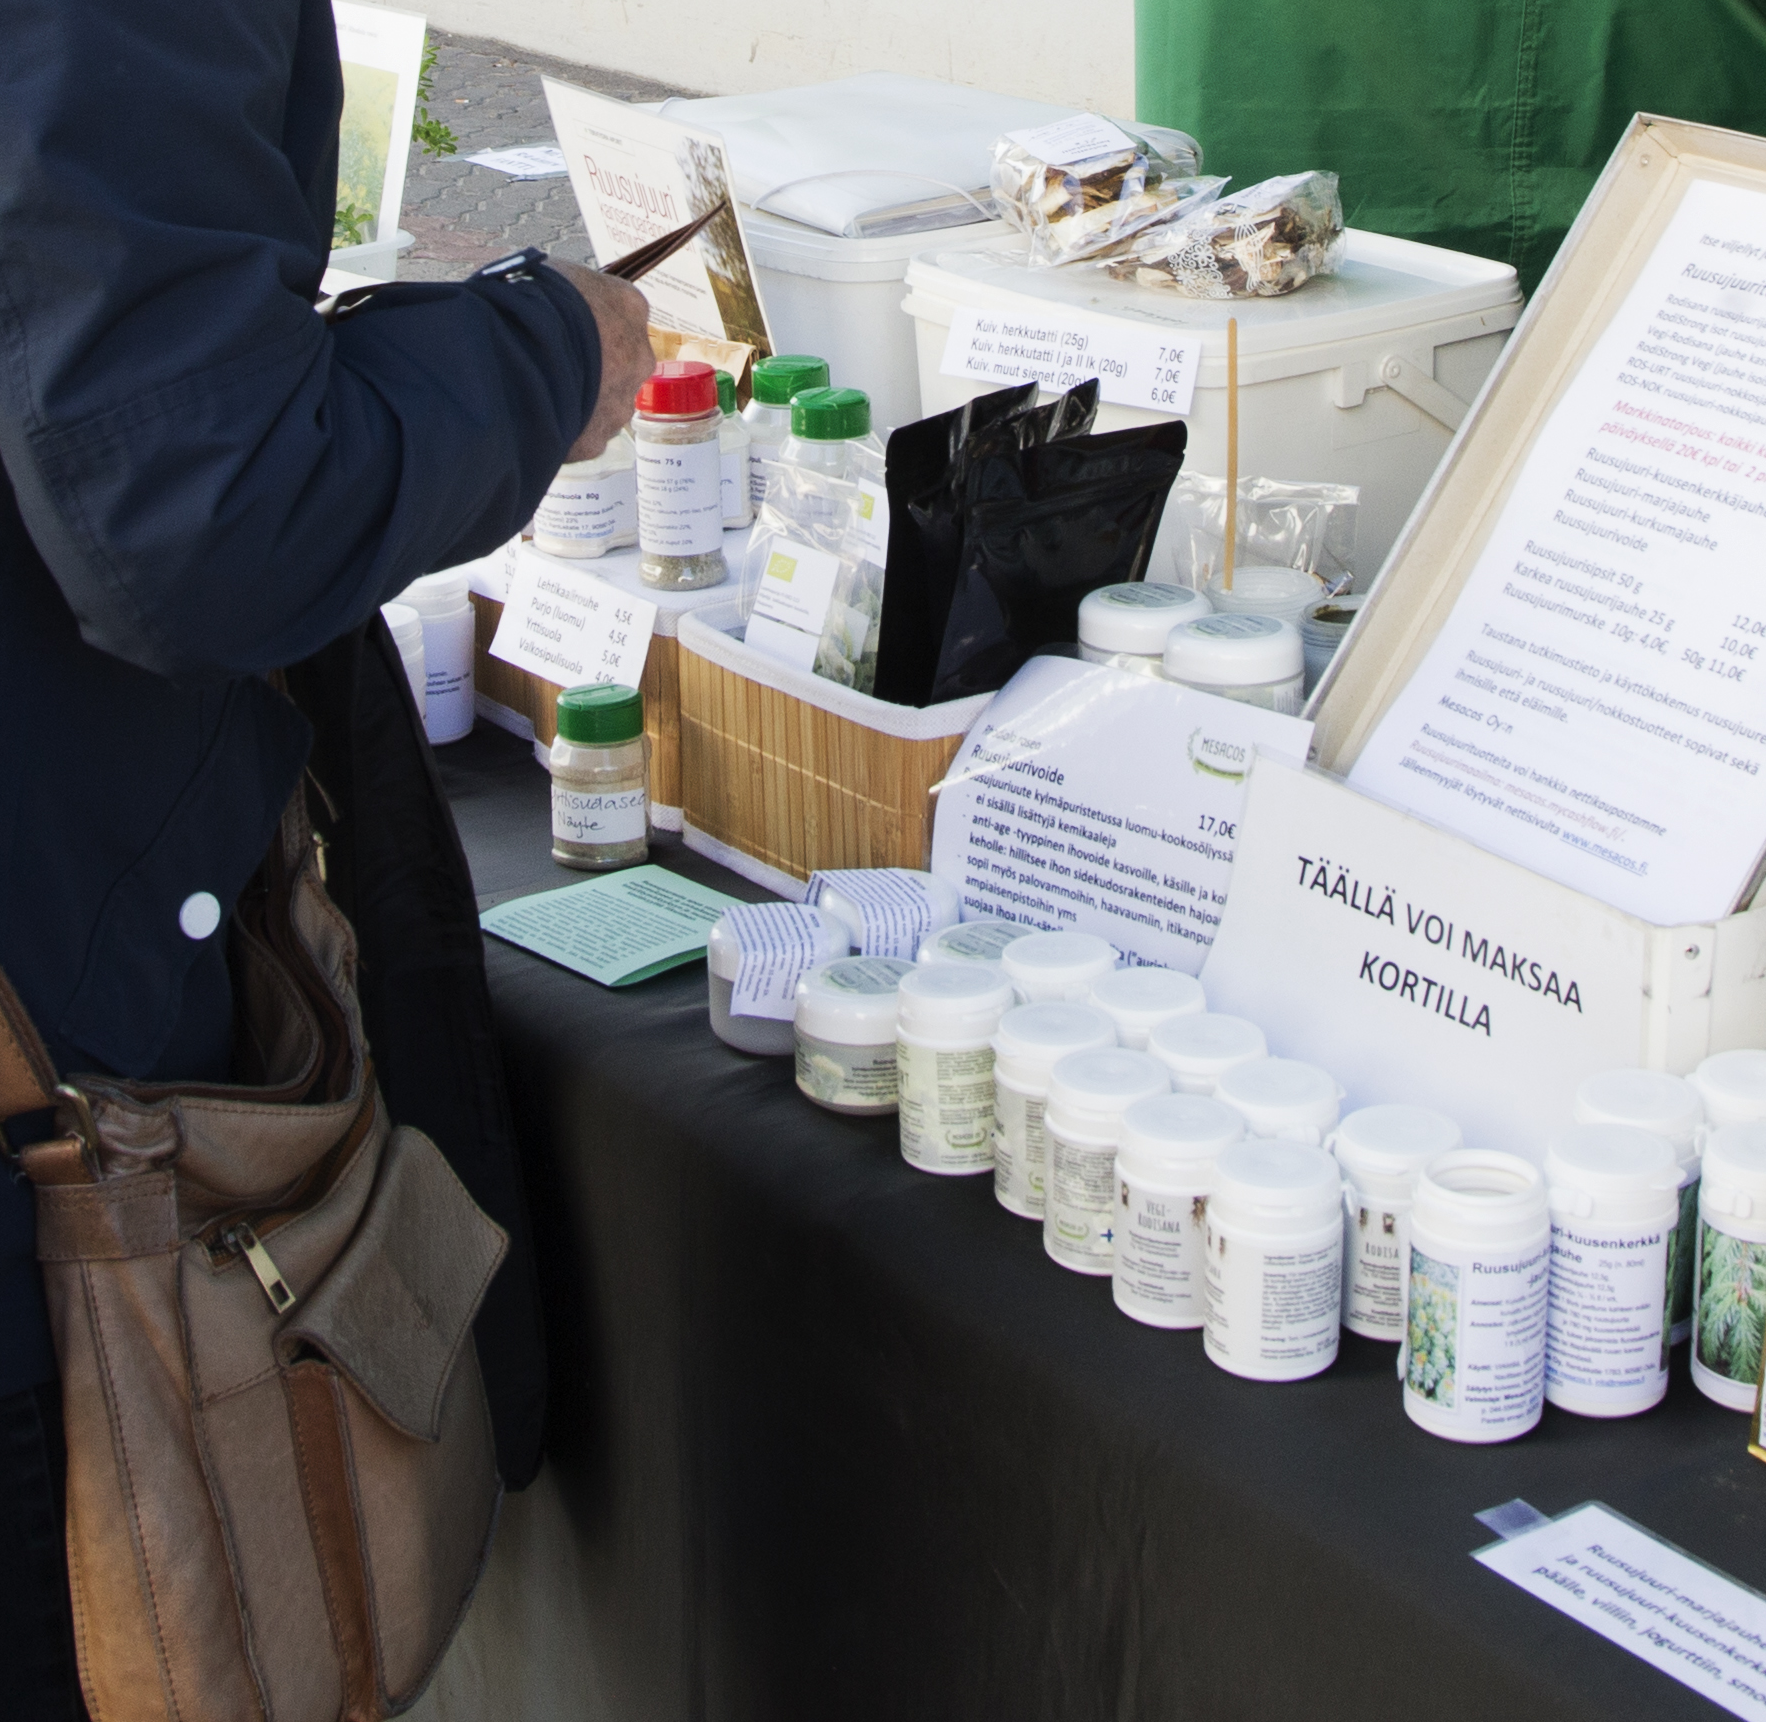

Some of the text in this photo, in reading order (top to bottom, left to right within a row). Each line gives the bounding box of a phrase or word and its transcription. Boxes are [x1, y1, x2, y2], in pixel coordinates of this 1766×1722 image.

[584, 154, 680, 223] Ruusujuuri
[970, 337, 996, 353] Kuiv.
[996, 341, 1054, 363] herkkutatti
[1059, 351, 1074, 369] ja
[1097, 357, 1128, 379] (20g)
[1154, 366, 1181, 385] 7,0€
[974, 318, 1185, 365] Kuiv. herkkutatti (25g) 7,0€
[965, 356, 993, 372] Kuiv.
[992, 363, 1021, 378] muut
[1021, 367, 1056, 384] sienet
[1150, 386, 1177, 405] 6,0€
[1597, 421, 1677, 453] päiväyksellä
[1674, 442, 1703, 461] 20€
[1699, 450, 1725, 467] kpl
[1721, 458, 1744, 474] tai
[1743, 464, 1757, 479] 2
[1611, 399, 1714, 441] Markkinatarjous:
[1716, 431, 1756, 454] kaikki
[1563, 487, 1719, 552] Ruusujuuri-kurkumajauhe
[1573, 466, 1712, 524] Ruusujuuri-marjajauhe
[1552, 508, 1649, 553] Ruusujuurivoide
[1523, 538, 1617, 583] Ruusujuurisipsit
[1616, 572, 1635, 589] 50
[1631, 580, 1644, 596] g
[1502, 581, 1747, 683] Ruusujuurimurske 10g: 4,0€, 50g 11,0€
[1512, 560, 1759, 661] Karkea ruusujuurijauhe 25 g 10,0€
[1437, 694, 1514, 734] Mesacos Oy:n
[1200, 737, 1246, 763] MESACOS
[969, 742, 1237, 840] Ruusujuurivoide 17,0€
[975, 793, 1117, 850] ei sisällä lisättyjä kemikaaleja
[1033, 788, 1123, 829] kylmäpuristetussa
[1124, 817, 1234, 864] luomu-kookosöljyssä
[968, 831, 1007, 856] keholle:
[1008, 844, 1047, 870] hillitsee
[1048, 858, 1072, 877] ihon
[1072, 868, 1187, 915] sidekudosrakenteiden
[971, 814, 1011, 837] anti-age
[1012, 827, 1066, 853] -tyyppinen
[1066, 842, 1111, 869] ihovoide
[1111, 857, 1160, 887] kasvoille,
[1162, 873, 1197, 897] käsille
[1197, 888, 1209, 901] ja
[964, 874, 1077, 923] ampiaisenpistoihin yms
[966, 854, 990, 871] sopii
[990, 862, 1017, 881] myös
[1017, 872, 1098, 911] palovammoihin,
[1099, 896, 1164, 933] haavaumiin,
[1296, 854, 1583, 1014] TÄÄLLÄ VOI MAKSAA
[1358, 950, 1492, 1037] KORTILLA
